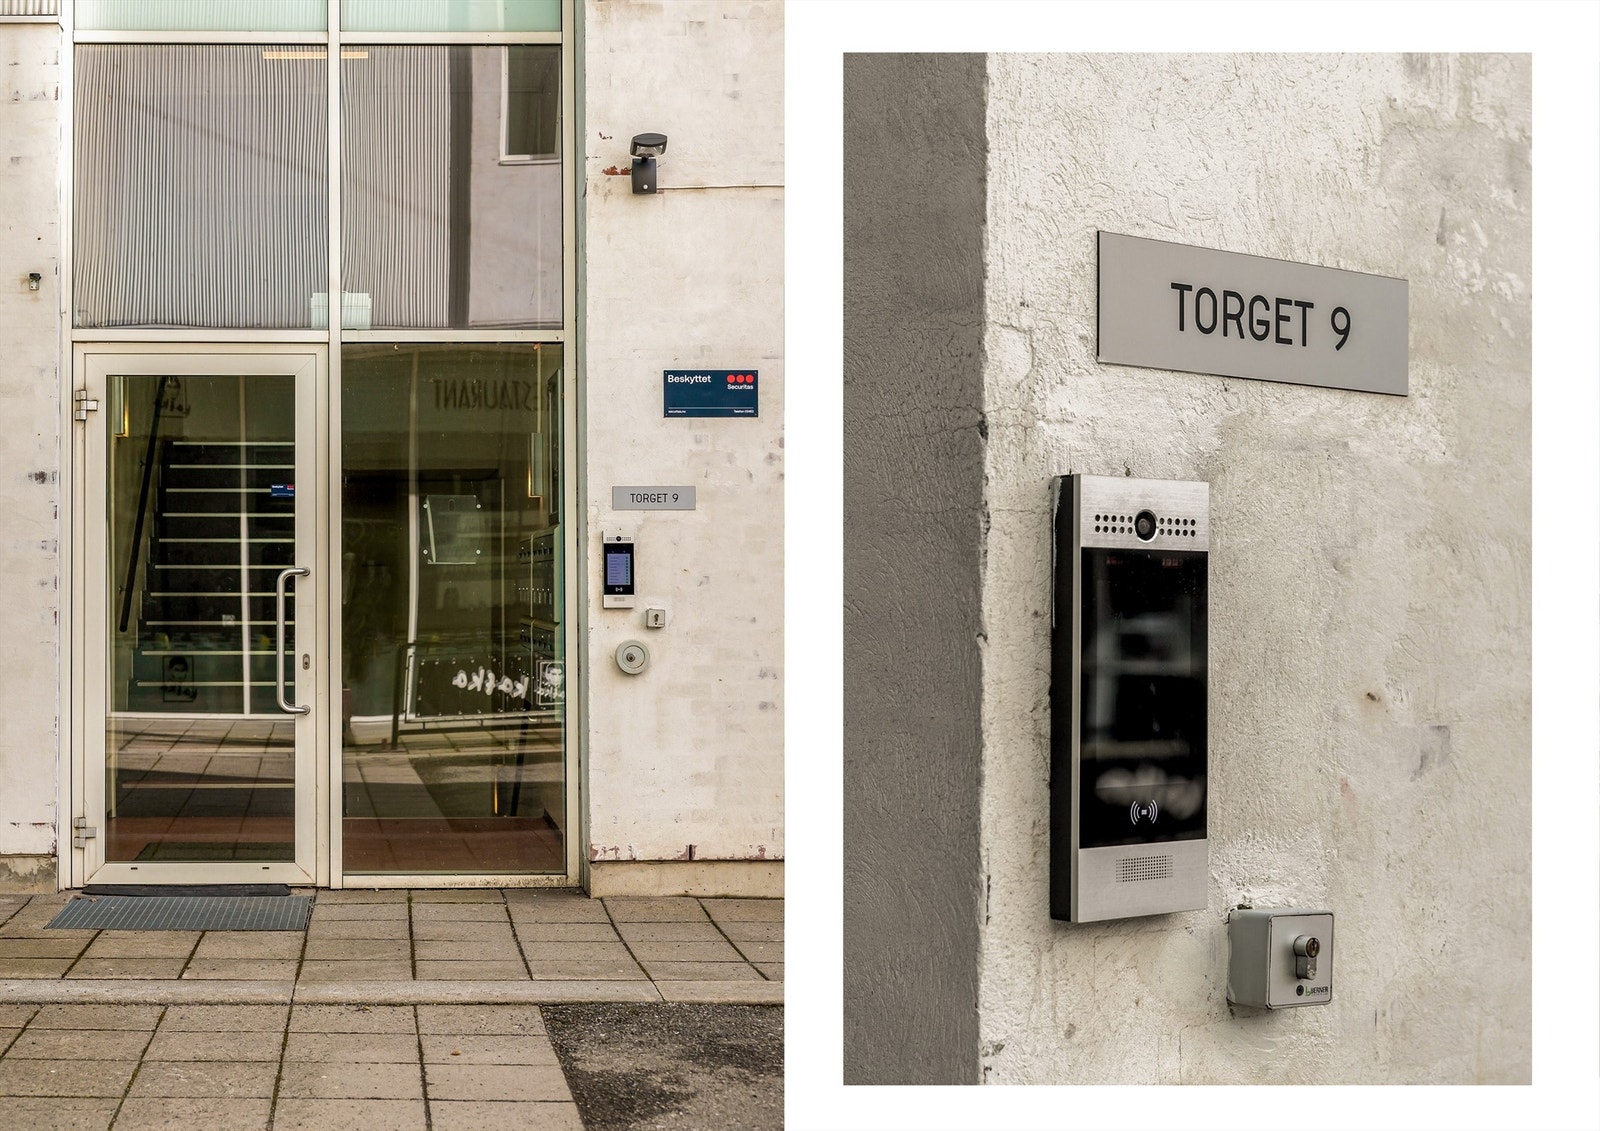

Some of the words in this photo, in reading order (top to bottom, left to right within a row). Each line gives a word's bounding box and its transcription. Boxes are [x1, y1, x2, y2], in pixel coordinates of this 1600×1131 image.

[1170, 282, 1315, 347] TORGET
[1330, 306, 1351, 352] 9
[667, 374, 712, 384] Beskyttet
[630, 493, 668, 503] TORGET
[672, 493, 679, 503] 9
